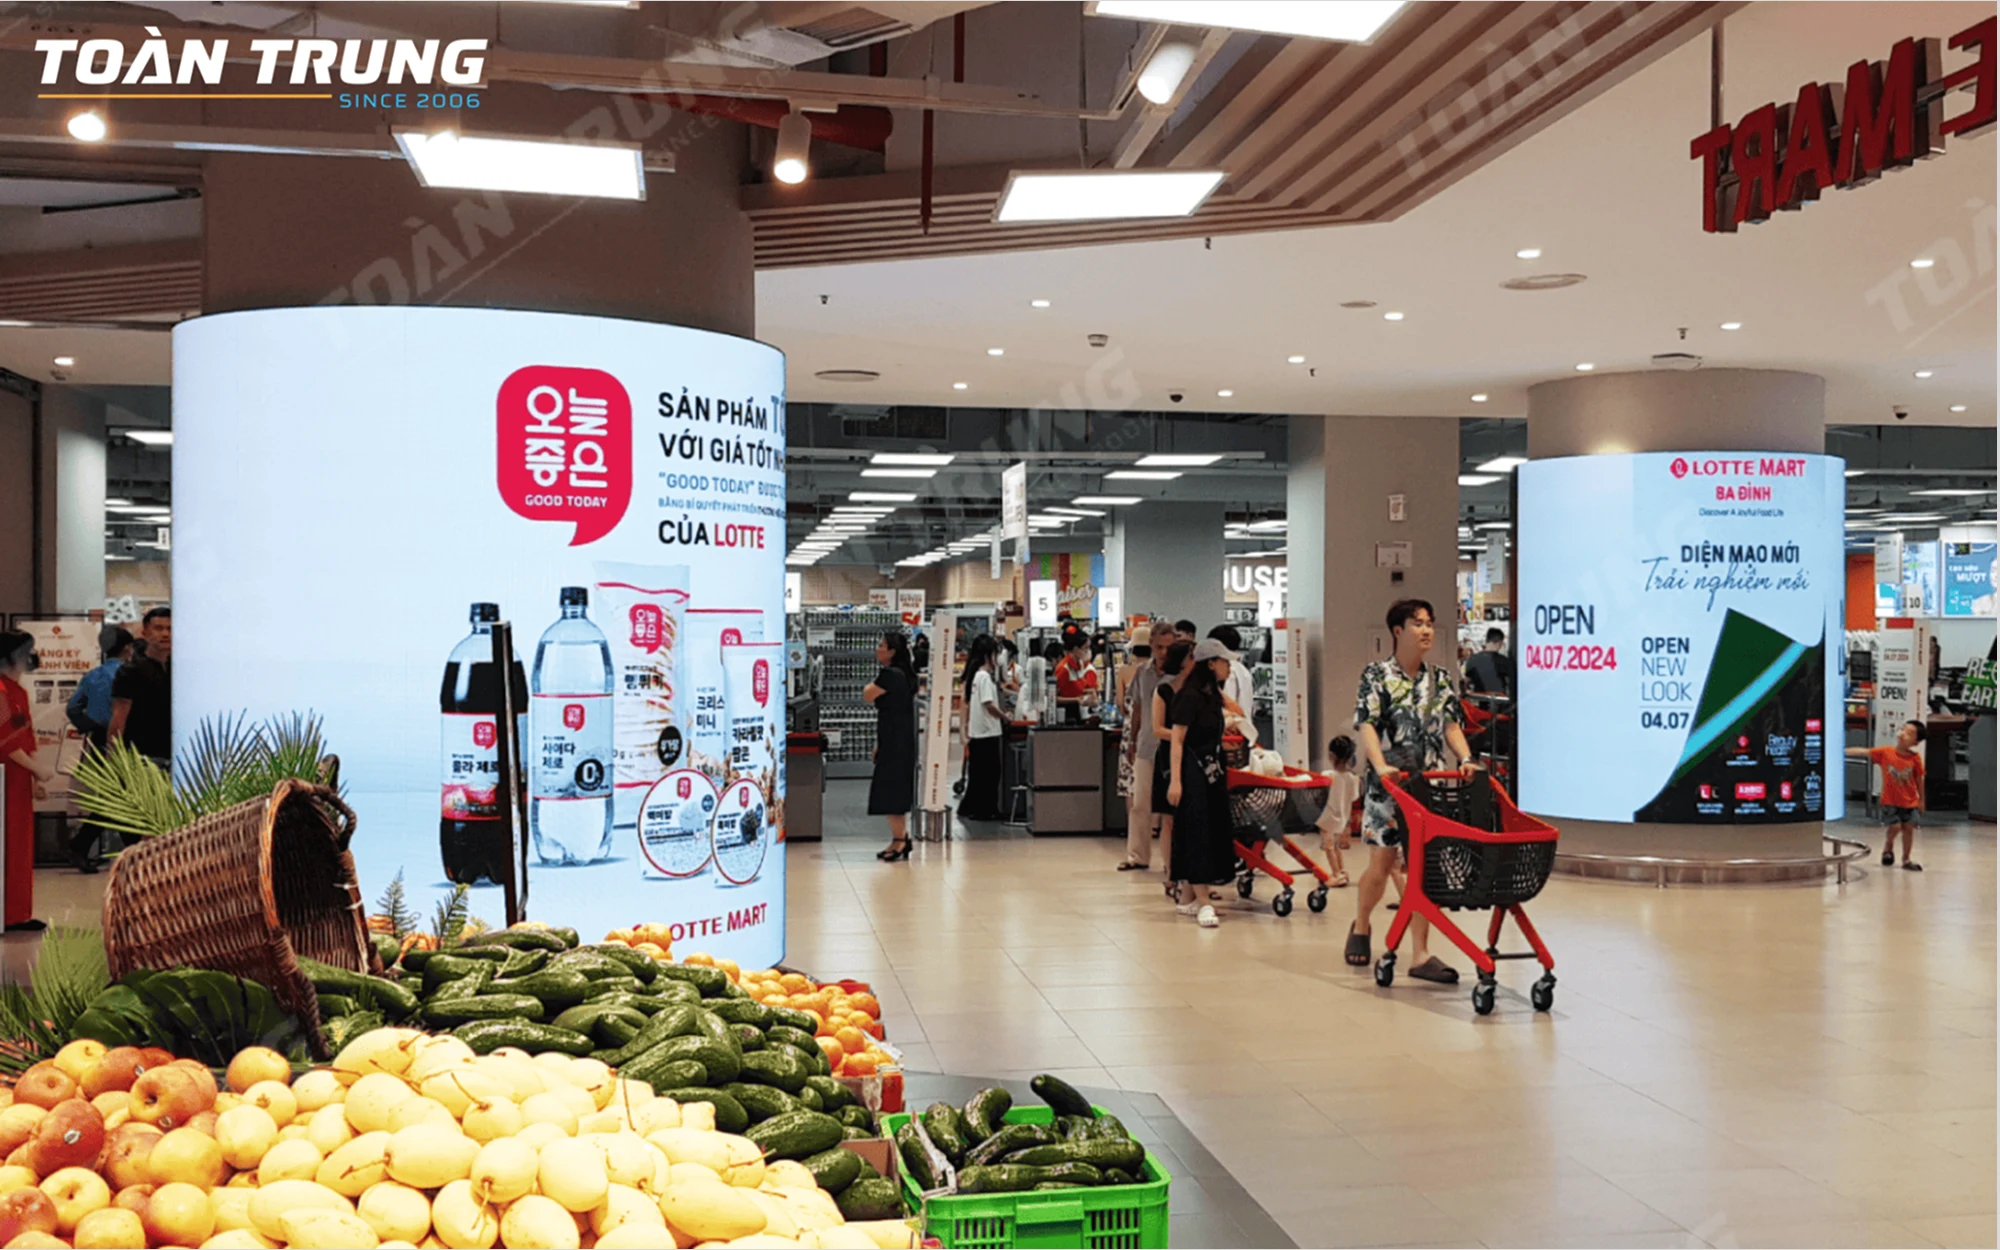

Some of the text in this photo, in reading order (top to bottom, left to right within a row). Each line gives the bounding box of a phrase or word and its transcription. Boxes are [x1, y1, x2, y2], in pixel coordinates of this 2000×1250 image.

[658, 386, 710, 422] SẢN
[658, 428, 703, 461] VỚI
[710, 434, 745, 465] GIÁ
[746, 439, 773, 469] TỐT
[1692, 458, 1806, 477] LOTTE MART
[525, 494, 608, 507] GOOD TODAY
[1715, 485, 1735, 501] BA
[658, 513, 764, 549] CỦA LOTTE
[1681, 540, 1800, 569] DIỆN MẠO MỚI
[1641, 556, 1690, 592] Trải
[1038, 598, 1048, 611] 5
[1105, 602, 1113, 613] 6
[1266, 601, 1275, 612] 7
[1909, 597, 1921, 609] 10
[1534, 604, 1595, 635] OPEN
[1641, 637, 1690, 654] OPEN
[1526, 644, 1617, 671] 04.07.2024
[1641, 657, 1687, 676] NEW
[1641, 681, 1693, 702] LOOK
[1881, 686, 1908, 701] OPEN!
[1641, 711, 1690, 730] 04.07
[542, 743, 576, 756] 사이다
[668, 902, 768, 942] OTTE MART
